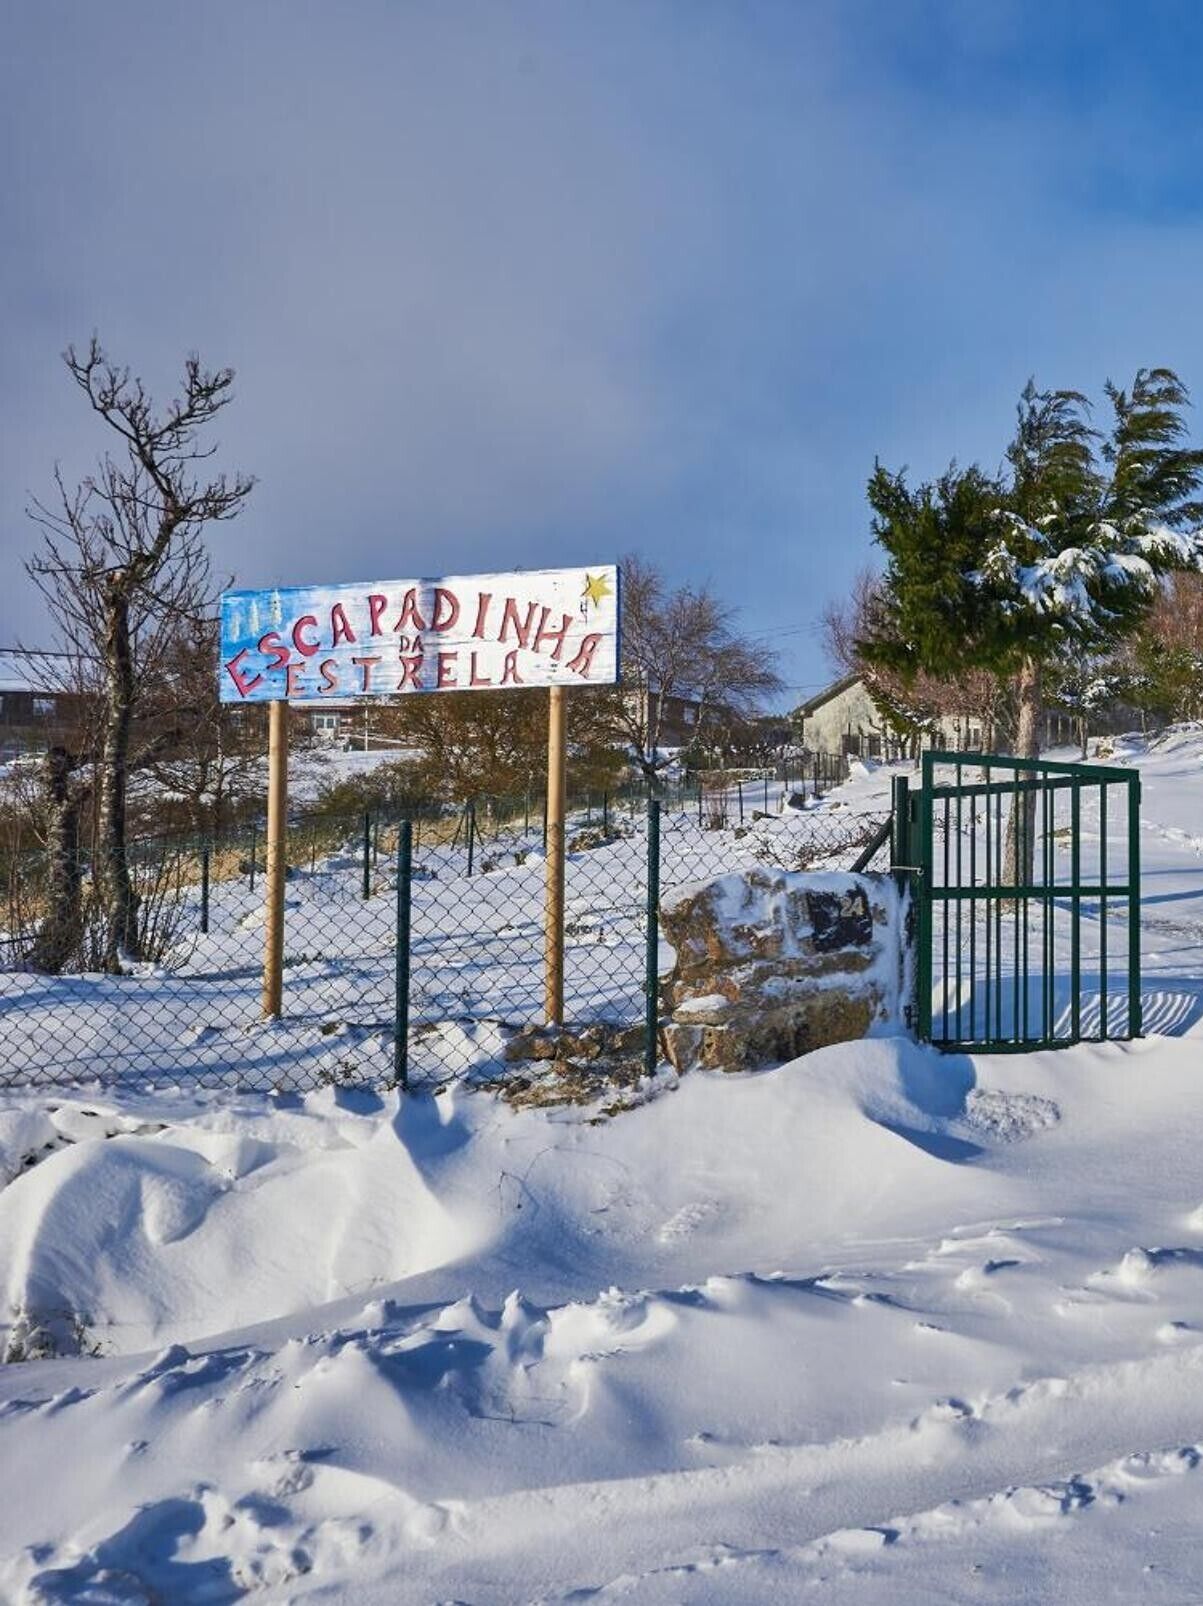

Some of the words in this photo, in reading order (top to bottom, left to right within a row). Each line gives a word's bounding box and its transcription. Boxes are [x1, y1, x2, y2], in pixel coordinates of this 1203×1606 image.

[225, 588, 603, 698] ESCAPADINHA
[400, 635, 424, 653] DA
[286, 649, 524, 696] ESTRELA
[840, 896, 864, 916] 24
